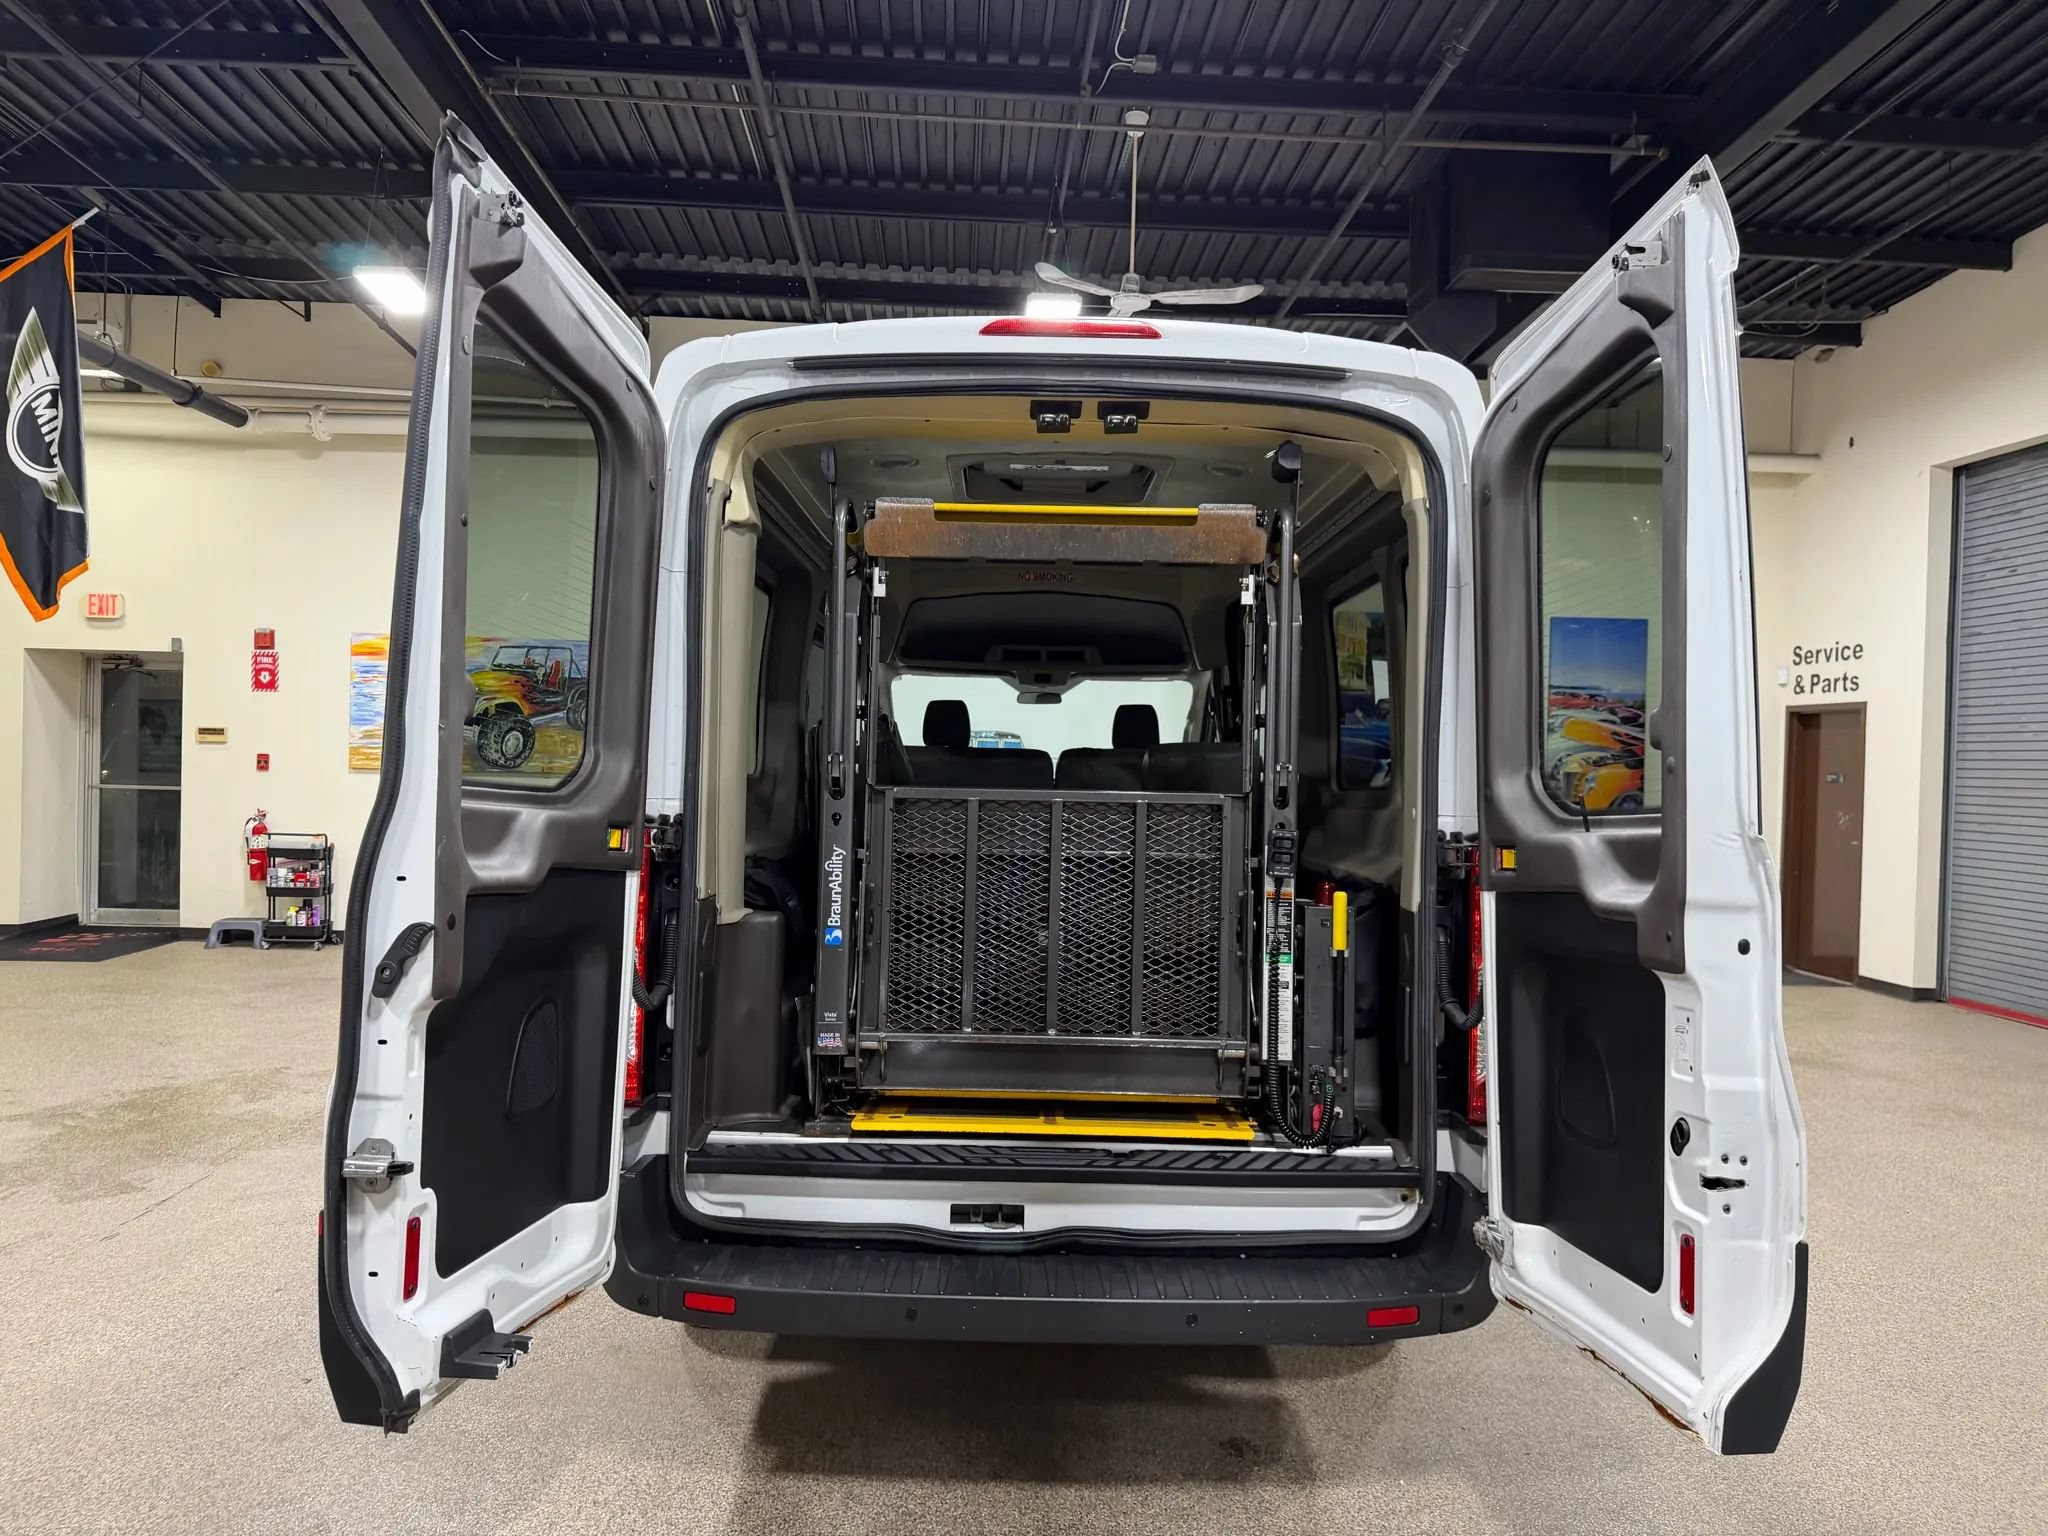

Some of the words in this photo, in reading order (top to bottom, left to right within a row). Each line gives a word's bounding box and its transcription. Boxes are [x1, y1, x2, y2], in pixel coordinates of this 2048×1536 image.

[31, 391, 61, 466] MIN
[1017, 571, 1031, 582] NO
[88, 593, 118, 616] EXIT
[256, 656, 274, 664] FIRE
[1792, 641, 1864, 666] Service
[1793, 674, 1805, 695] &
[1810, 672, 1860, 694] Parts
[825, 844, 847, 926] BraunAbility
